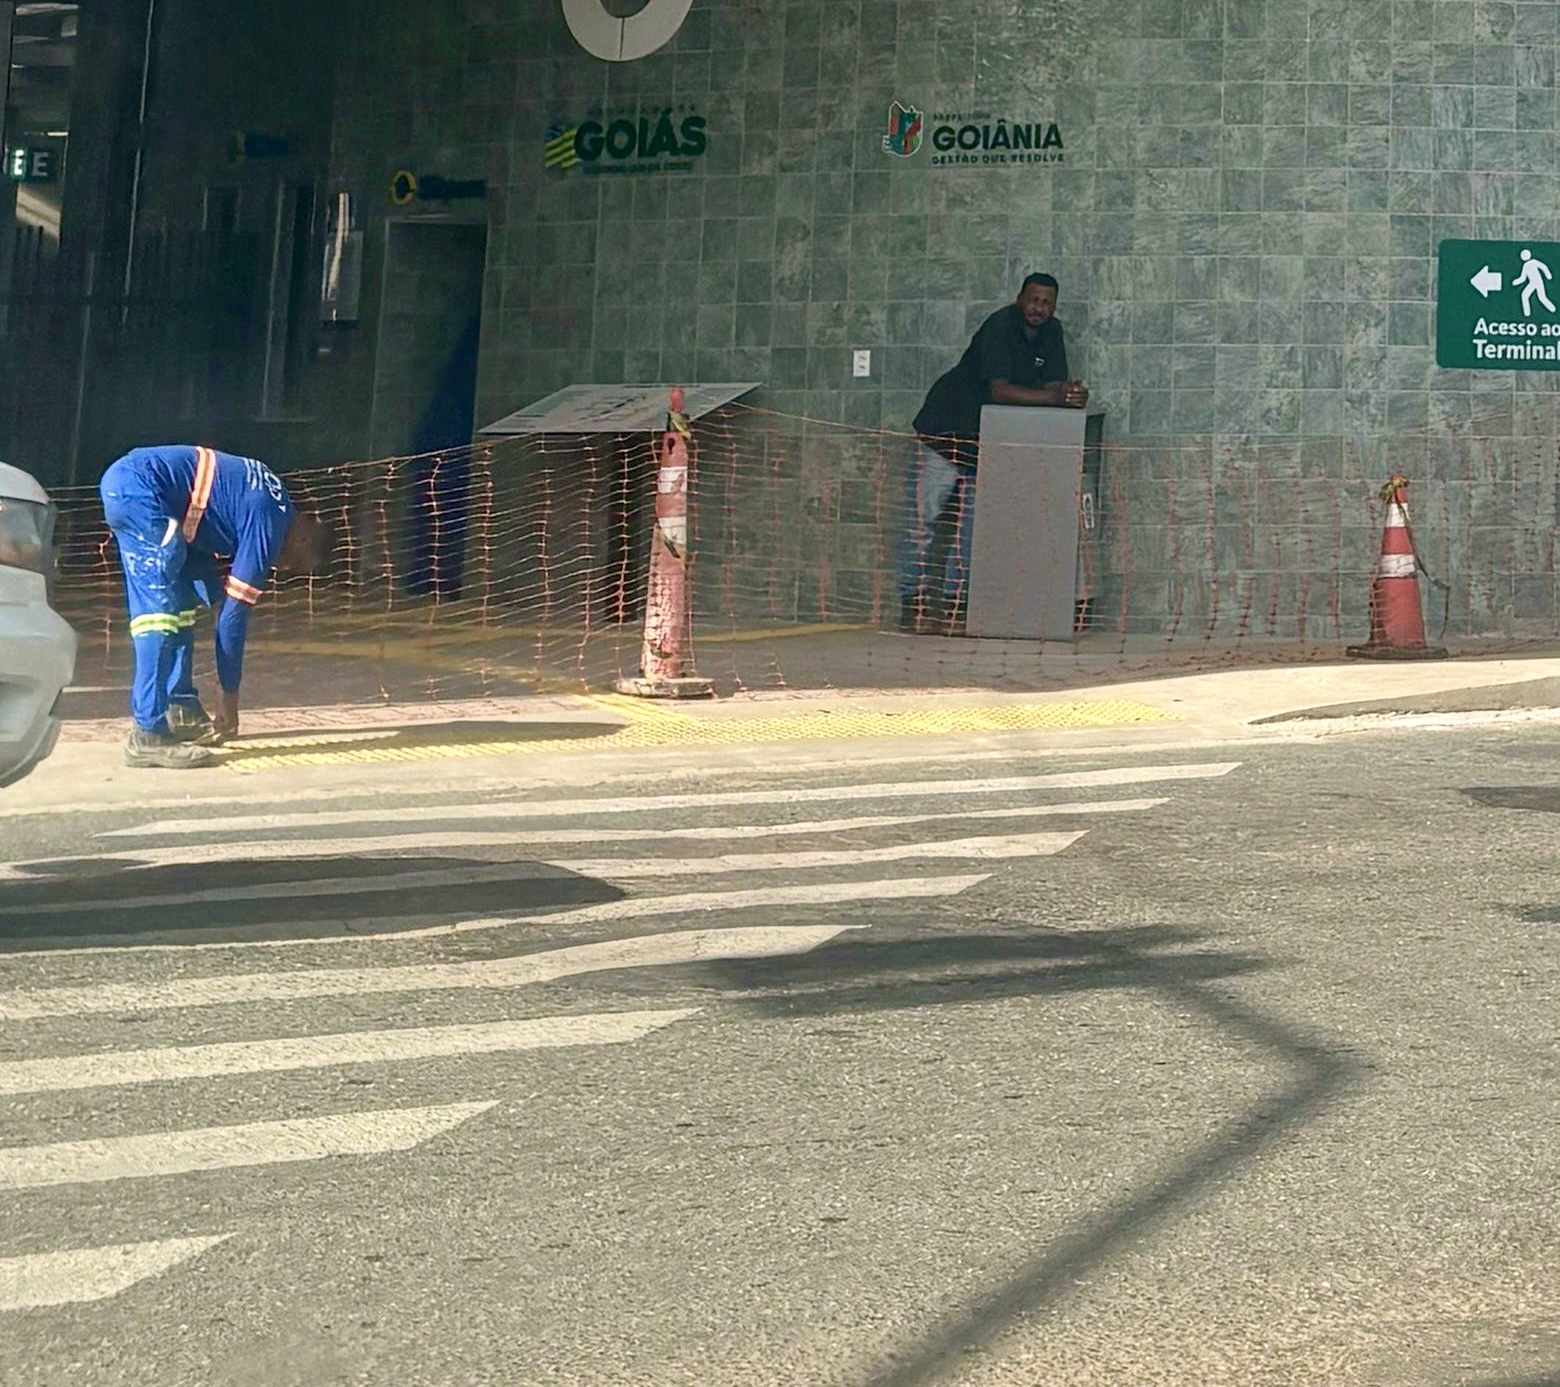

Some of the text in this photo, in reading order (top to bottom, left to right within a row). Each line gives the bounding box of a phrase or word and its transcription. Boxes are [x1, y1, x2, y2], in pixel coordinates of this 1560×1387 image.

[575, 108, 707, 160] GOIÁS
[932, 119, 1064, 151] GOIÂNIA
[1473, 317, 1538, 337] Acesso
